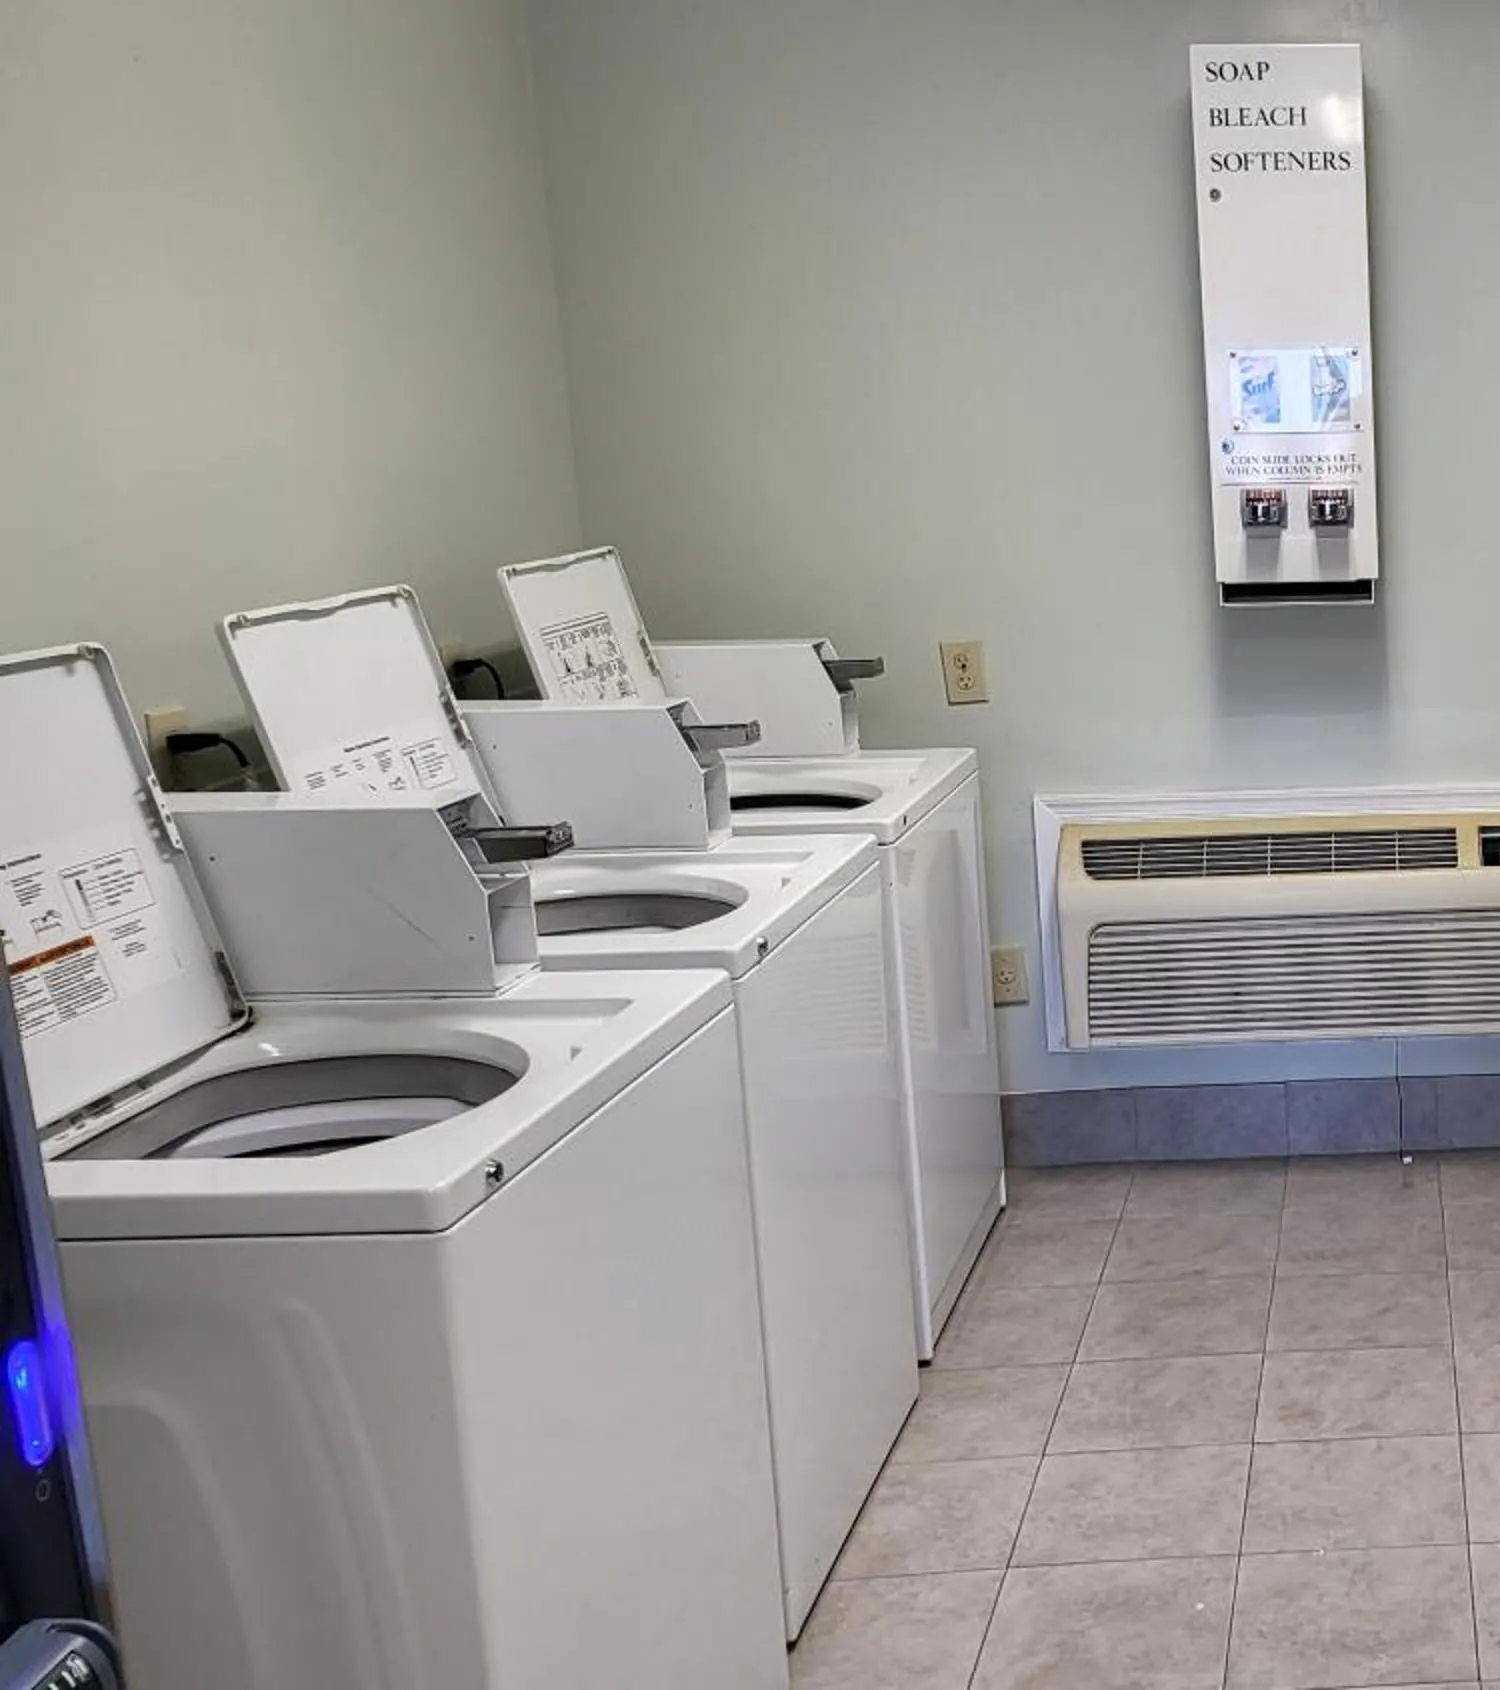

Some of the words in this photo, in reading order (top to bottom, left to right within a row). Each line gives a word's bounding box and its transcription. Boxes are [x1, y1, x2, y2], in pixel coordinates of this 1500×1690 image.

[1205, 61, 1270, 82] SOAP
[1209, 106, 1307, 127] BLEACH
[1210, 151, 1351, 173] SOFTENERS
[1225, 465, 1260, 475] WHEN
[1263, 465, 1311, 475] COLUMN
[1315, 465, 1323, 474] IS
[1327, 464, 1363, 475] EMPTY
[1231, 454, 1259, 465] COIN
[1262, 454, 1290, 465] SLIDE
[1295, 454, 1330, 465] LOCKS
[1334, 453, 1357, 464] OUT
